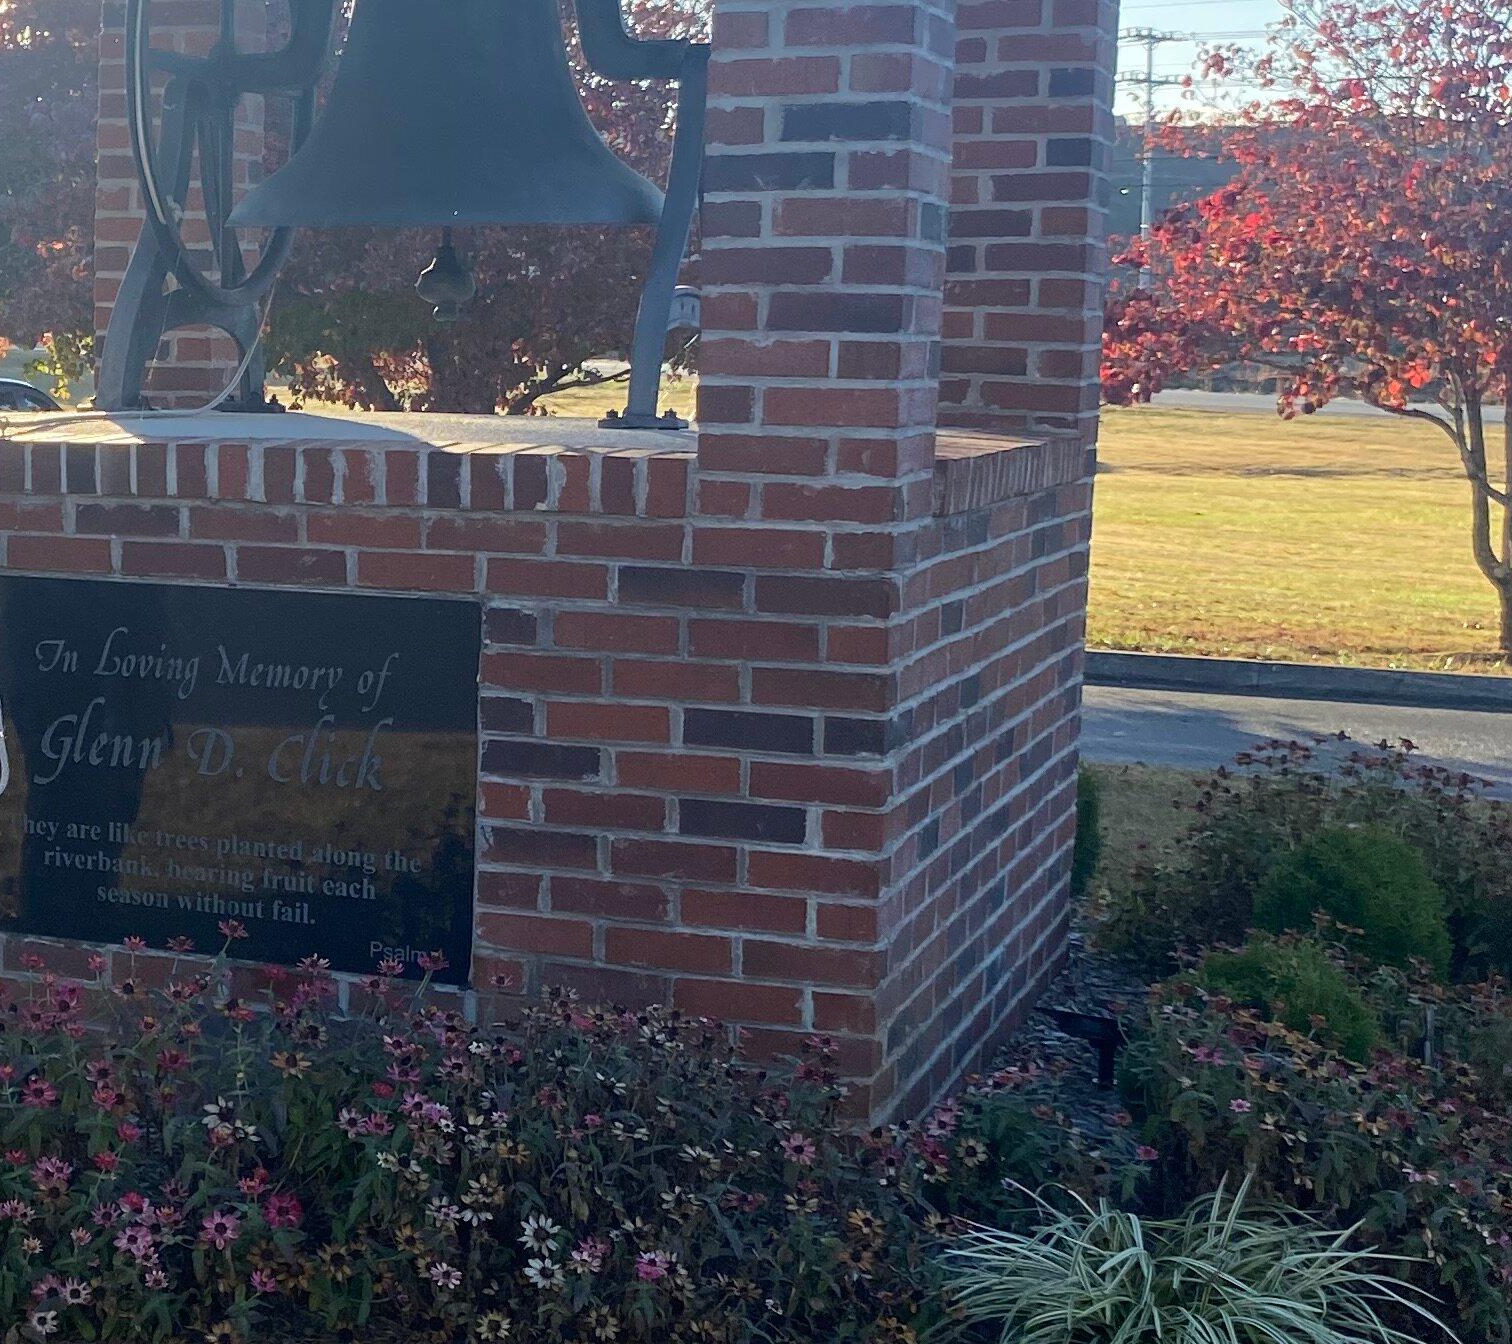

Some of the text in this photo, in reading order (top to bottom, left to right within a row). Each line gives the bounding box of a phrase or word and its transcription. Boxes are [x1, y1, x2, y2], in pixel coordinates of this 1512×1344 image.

[35, 626, 399, 712] In Loving Memory of
[33, 696, 394, 791] Glenn D. Click
[43, 846, 159, 877] riverbank,
[262, 867, 315, 894] fruit
[322, 877, 377, 901] each
[66, 822, 102, 842] are
[108, 821, 150, 844] like
[155, 829, 209, 852] trees
[216, 835, 304, 863] planted
[312, 843, 377, 875] along
[385, 850, 423, 874] the
[96, 885, 317, 926] season without fail.
